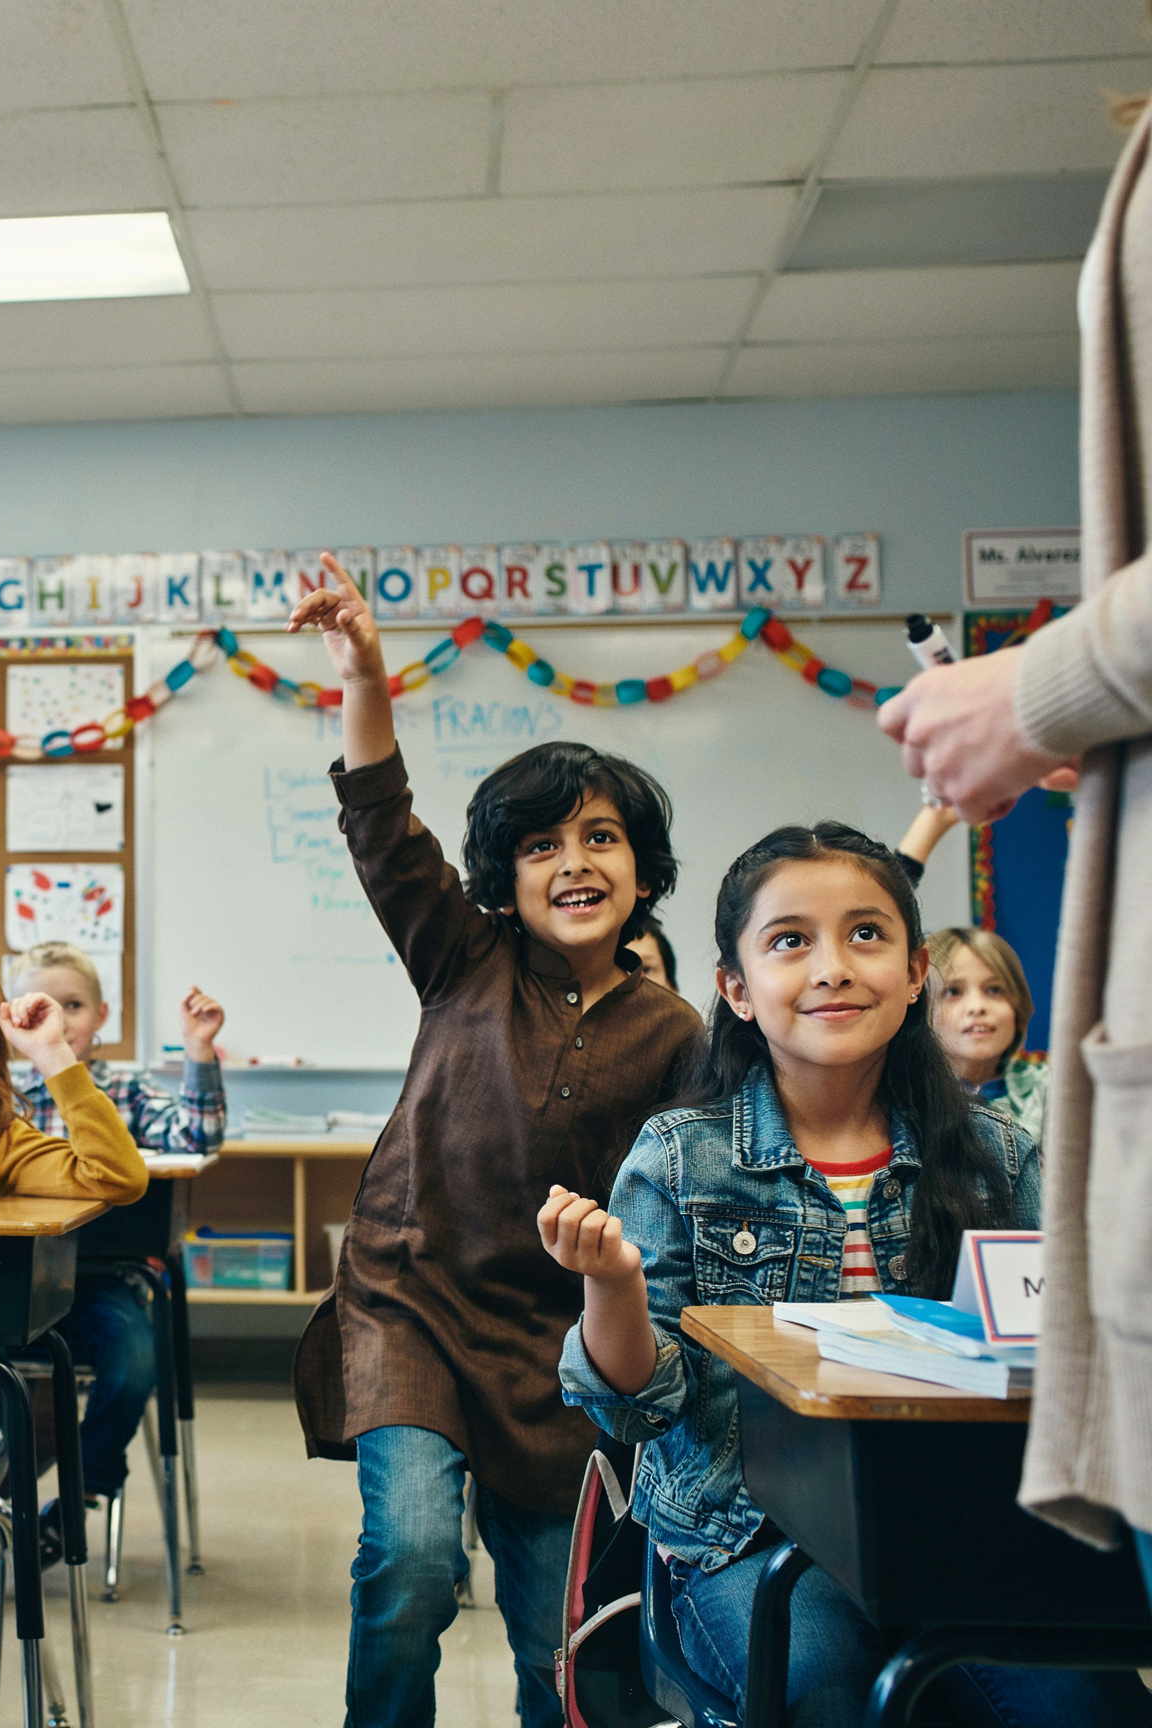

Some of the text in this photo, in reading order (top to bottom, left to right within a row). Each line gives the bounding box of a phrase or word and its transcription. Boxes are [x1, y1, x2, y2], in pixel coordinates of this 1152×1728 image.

[37, 581, 65, 611] H
[87, 578, 100, 611] I
[127, 578, 143, 611] J
[167, 576, 190, 607] K
[214, 573, 234, 607] L
[253, 571, 287, 603] M
[377, 567, 412, 602] O
[428, 567, 451, 600] P
[460, 567, 494, 601] Q
[505, 566, 529, 598] R
[545, 562, 567, 597] S
[577, 563, 604, 597] T
[611, 562, 641, 596] U
[648, 562, 678, 595] V
[689, 559, 734, 593] W
[748, 559, 772, 593] X
[787, 559, 812, 591] Y
[844, 556, 871, 591] Z
